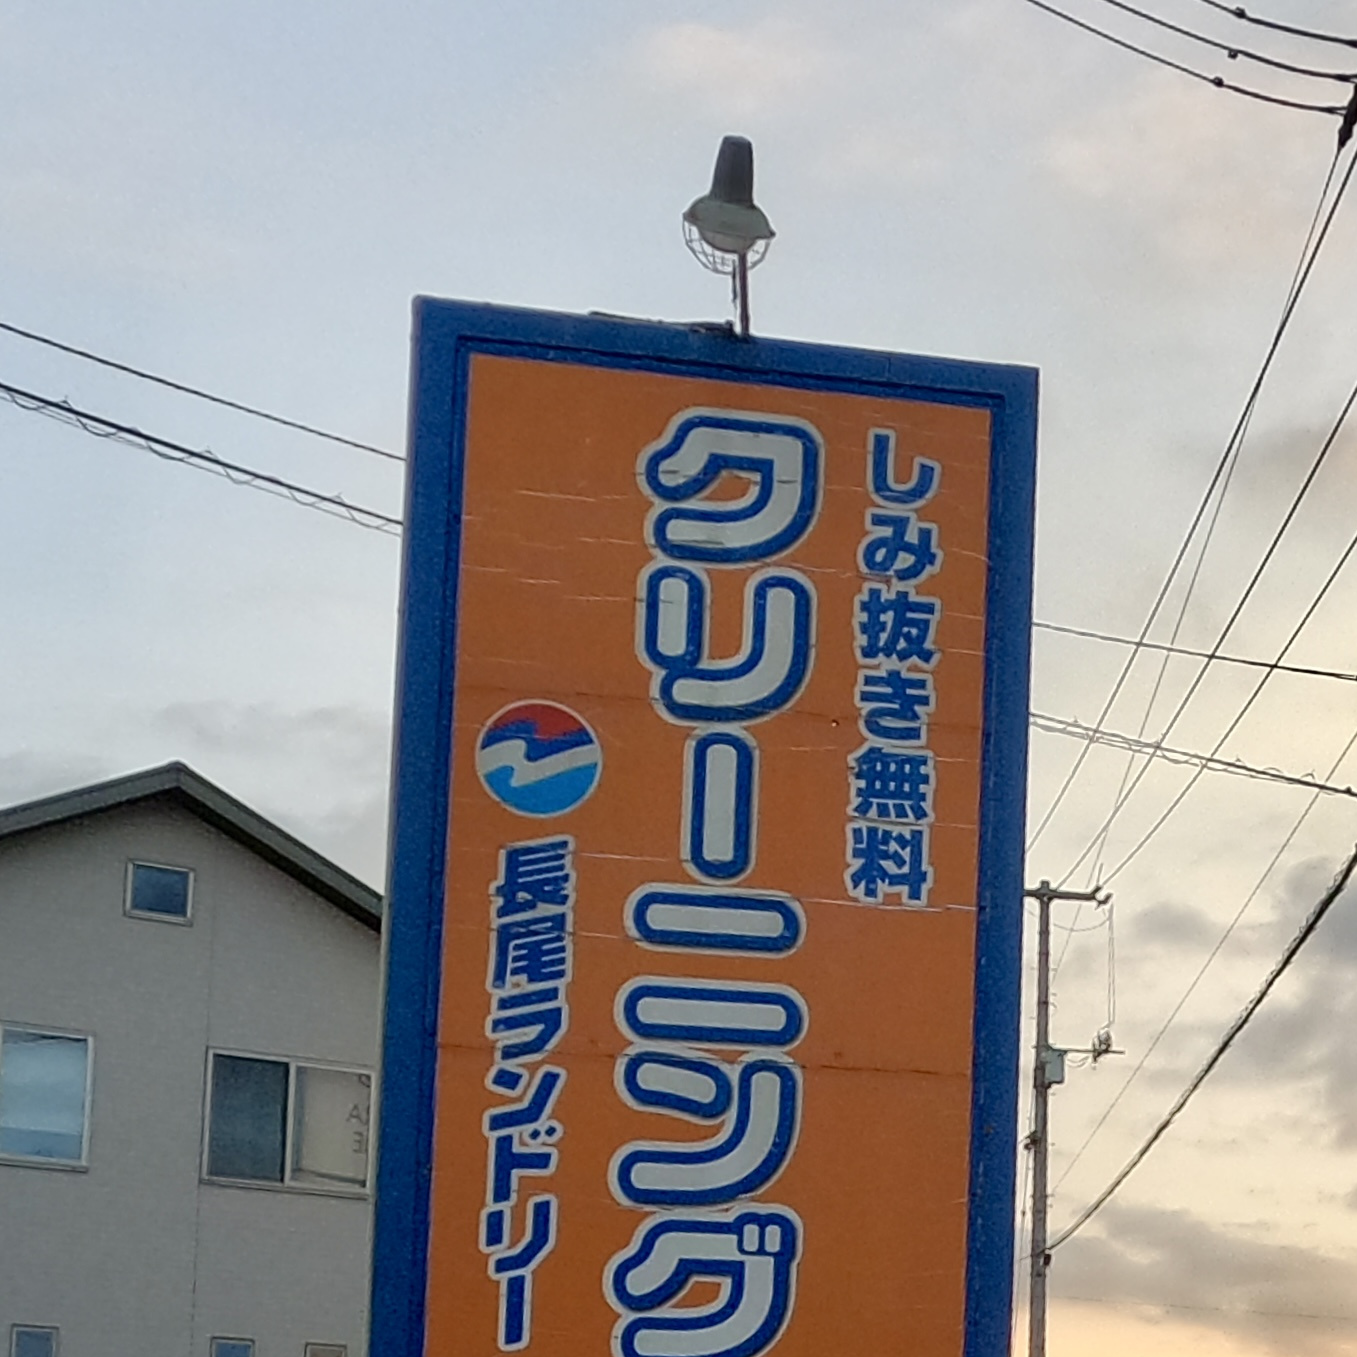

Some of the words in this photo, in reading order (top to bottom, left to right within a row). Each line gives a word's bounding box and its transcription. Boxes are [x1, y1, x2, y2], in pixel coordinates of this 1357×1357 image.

[848, 429, 942, 904] しみ抜き無料
[482, 837, 575, 1350] 長尾ランドリー
